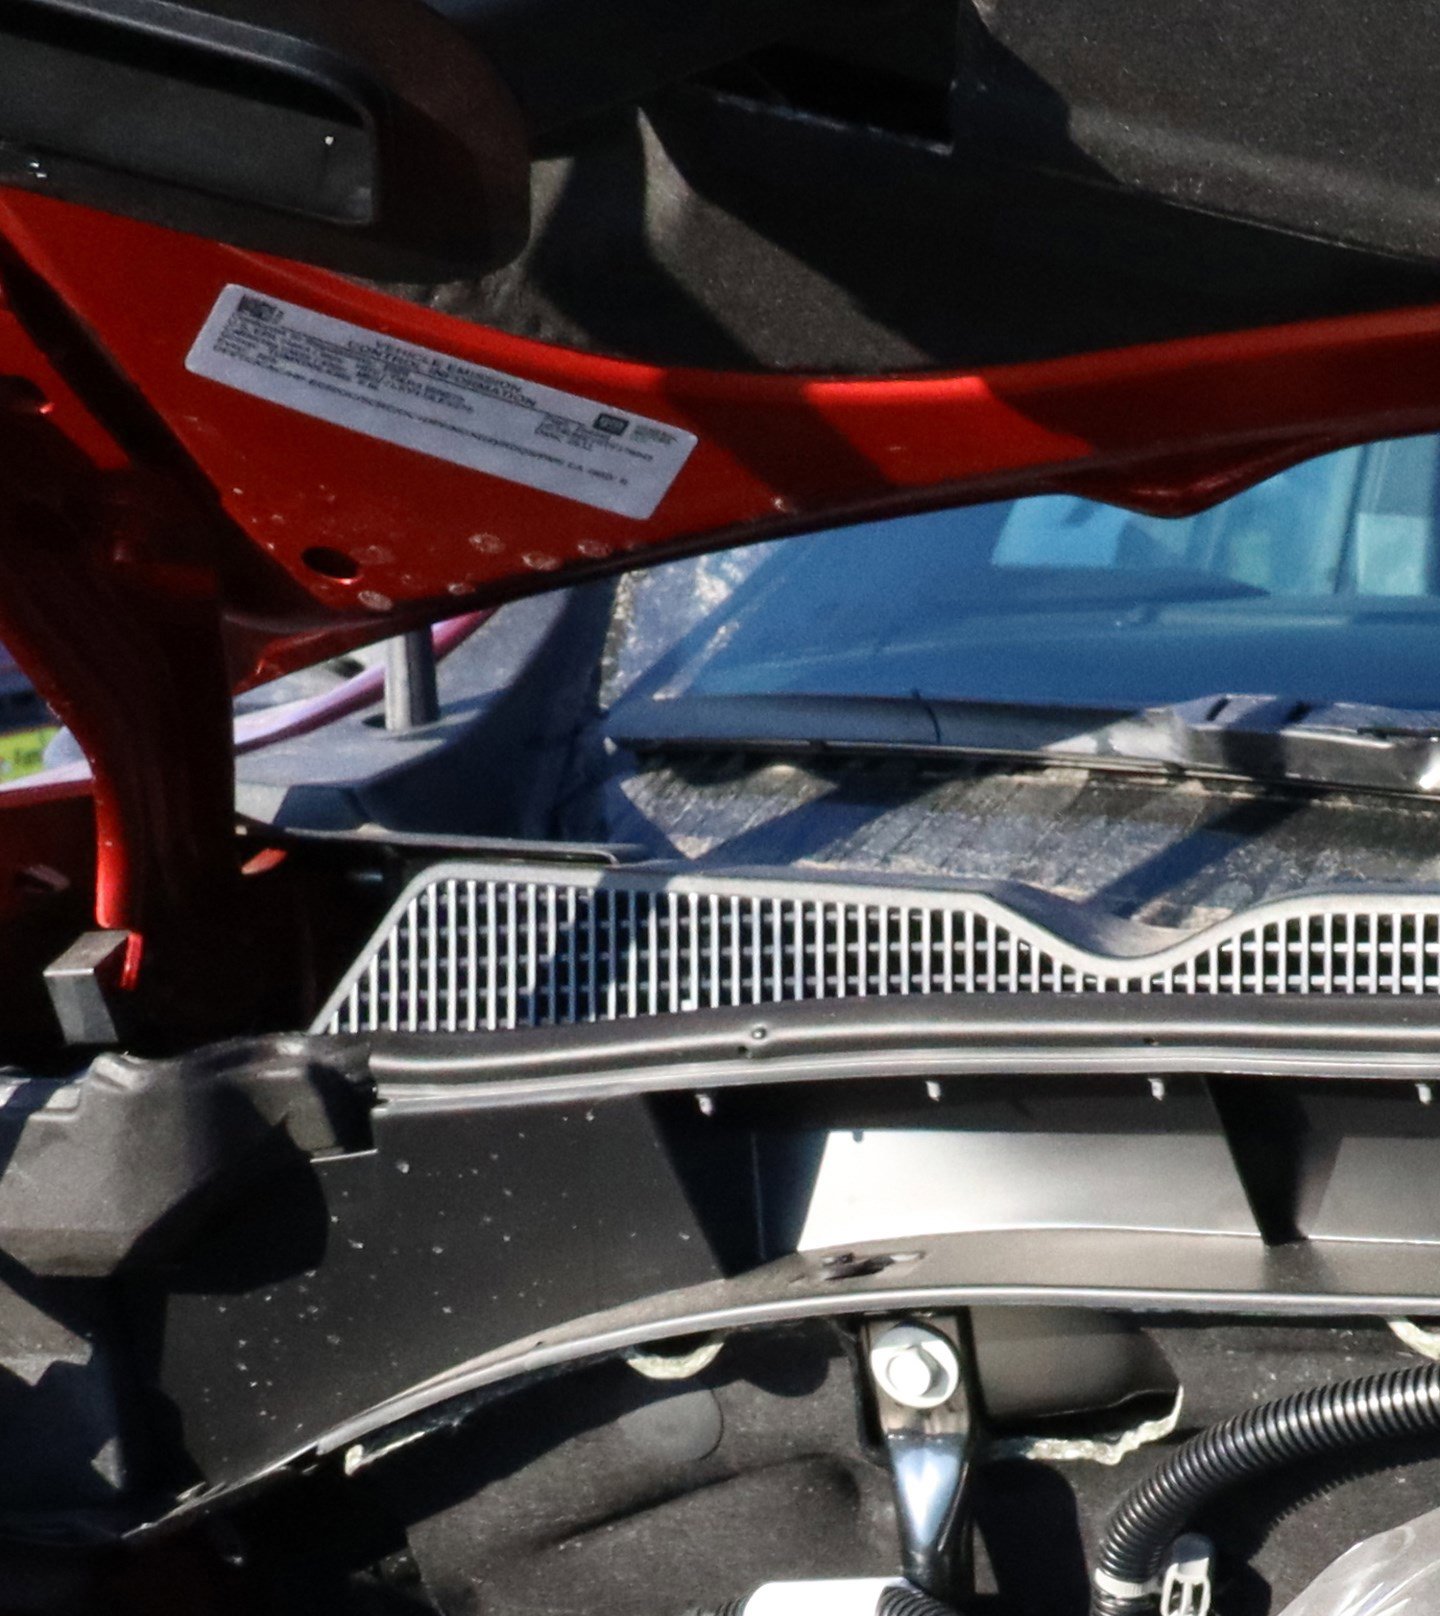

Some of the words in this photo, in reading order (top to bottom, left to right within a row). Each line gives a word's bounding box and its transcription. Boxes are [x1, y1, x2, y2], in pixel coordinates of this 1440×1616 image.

[347, 339, 422, 370] CONTROL
[427, 365, 537, 407] INFORMATION
[375, 340, 445, 368] VEHICLE
[444, 362, 523, 393] EMISSION
